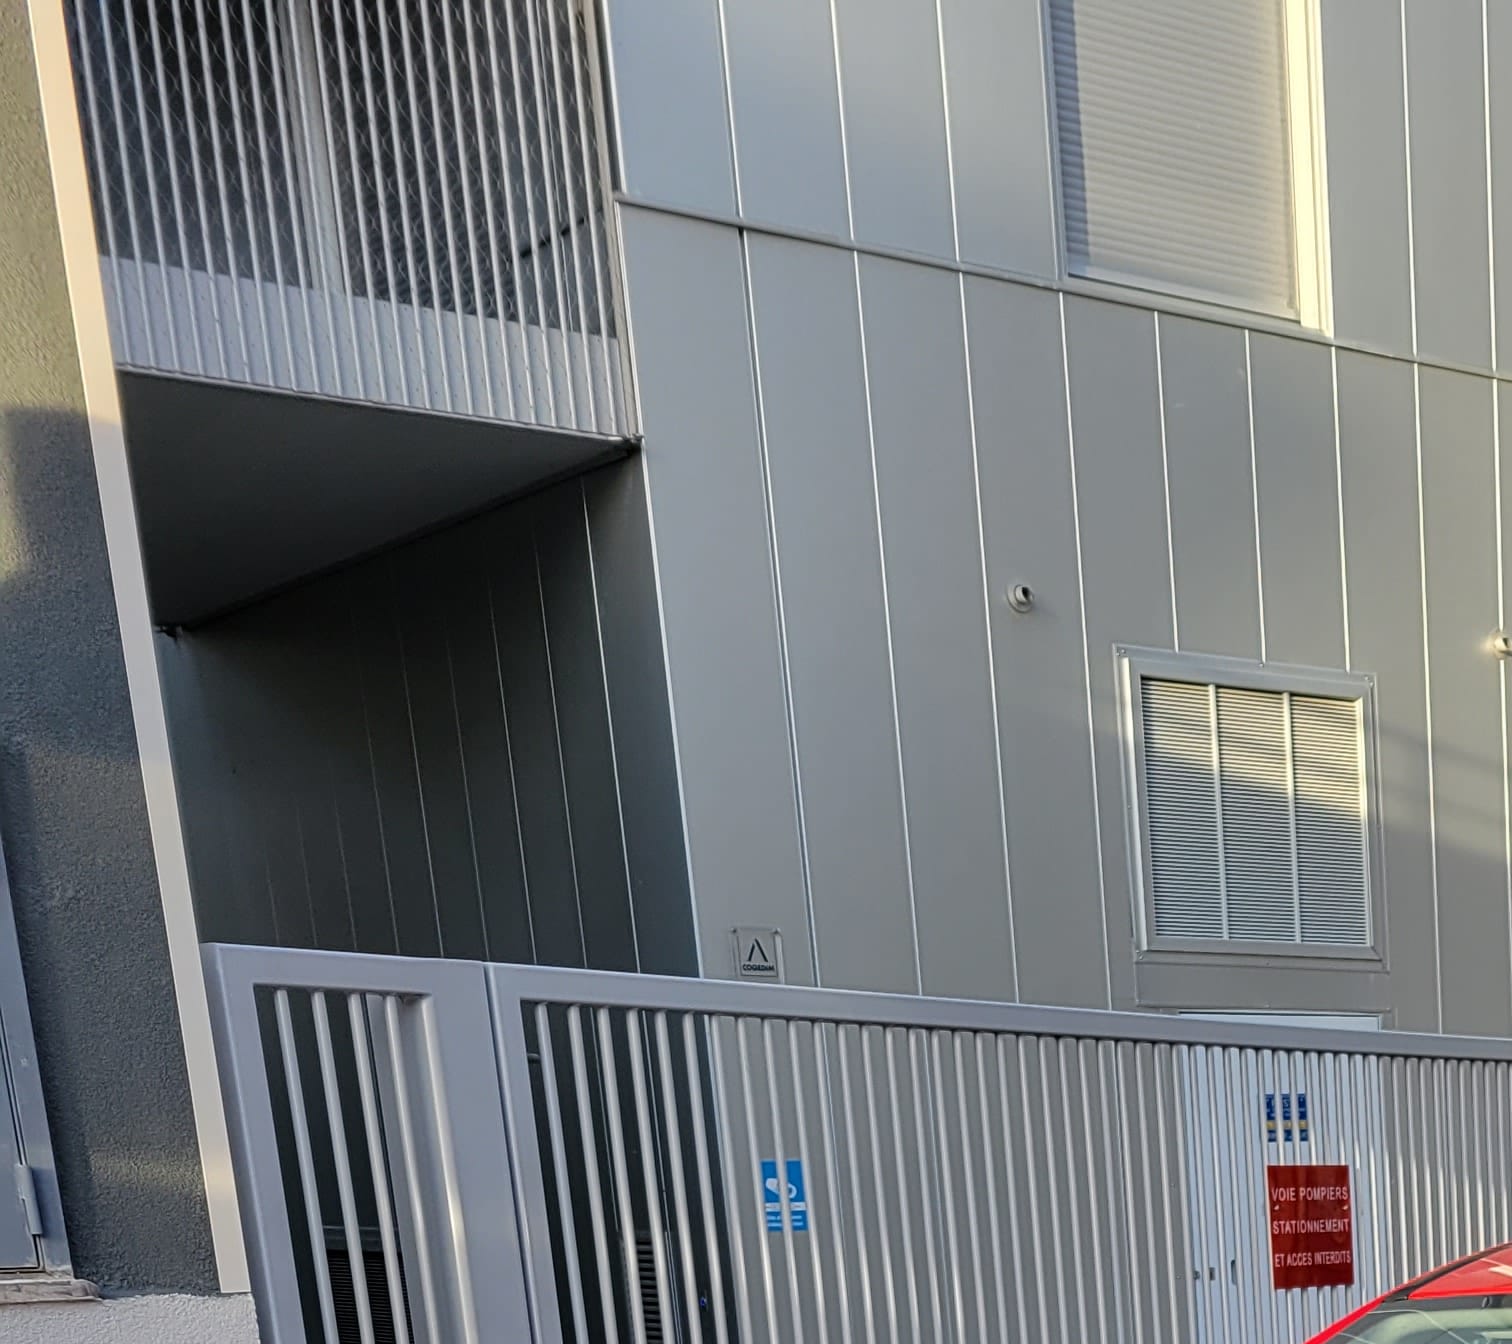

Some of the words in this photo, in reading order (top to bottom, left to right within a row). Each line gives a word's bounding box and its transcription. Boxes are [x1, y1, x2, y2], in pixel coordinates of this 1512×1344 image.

[1271, 1187, 1297, 1201] VOIE
[1299, 1186, 1348, 1201] POMPIERS
[1272, 1218, 1350, 1234] STATIONNEMENT
[1274, 1253, 1285, 1267] ET
[1287, 1252, 1312, 1266] ACCES
[1314, 1250, 1351, 1265] INTERDITS
